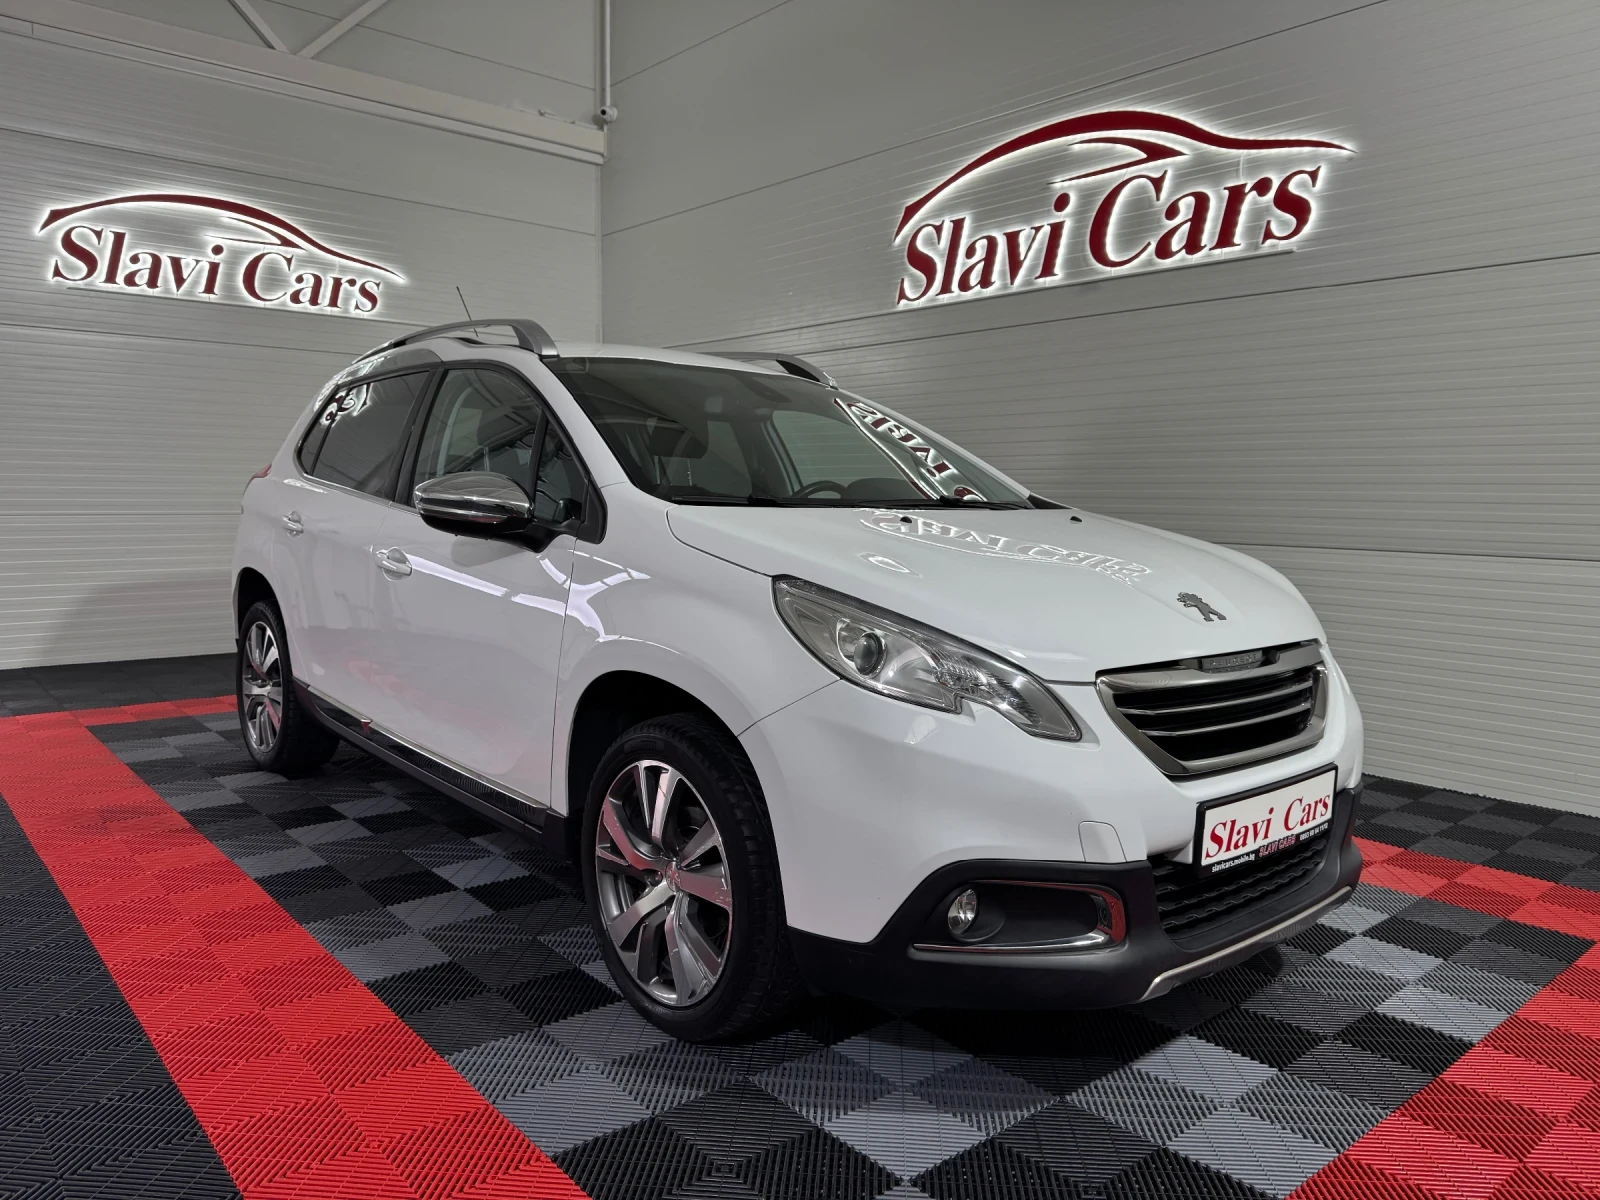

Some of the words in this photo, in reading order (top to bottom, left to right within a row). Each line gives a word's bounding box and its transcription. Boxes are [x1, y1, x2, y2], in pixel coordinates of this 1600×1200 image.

[51, 225, 225, 296] Slavi
[242, 251, 382, 313] Cars
[896, 192, 1071, 304] Slavi
[1088, 165, 1322, 268] Cars
[1204, 807, 1274, 860] Slavi
[1283, 796, 1331, 831] Cars
[1211, 853, 1256, 873] slavicars.mobile.bg
[1258, 841, 1278, 858] SLAVI
[1278, 834, 1297, 850] CARS
